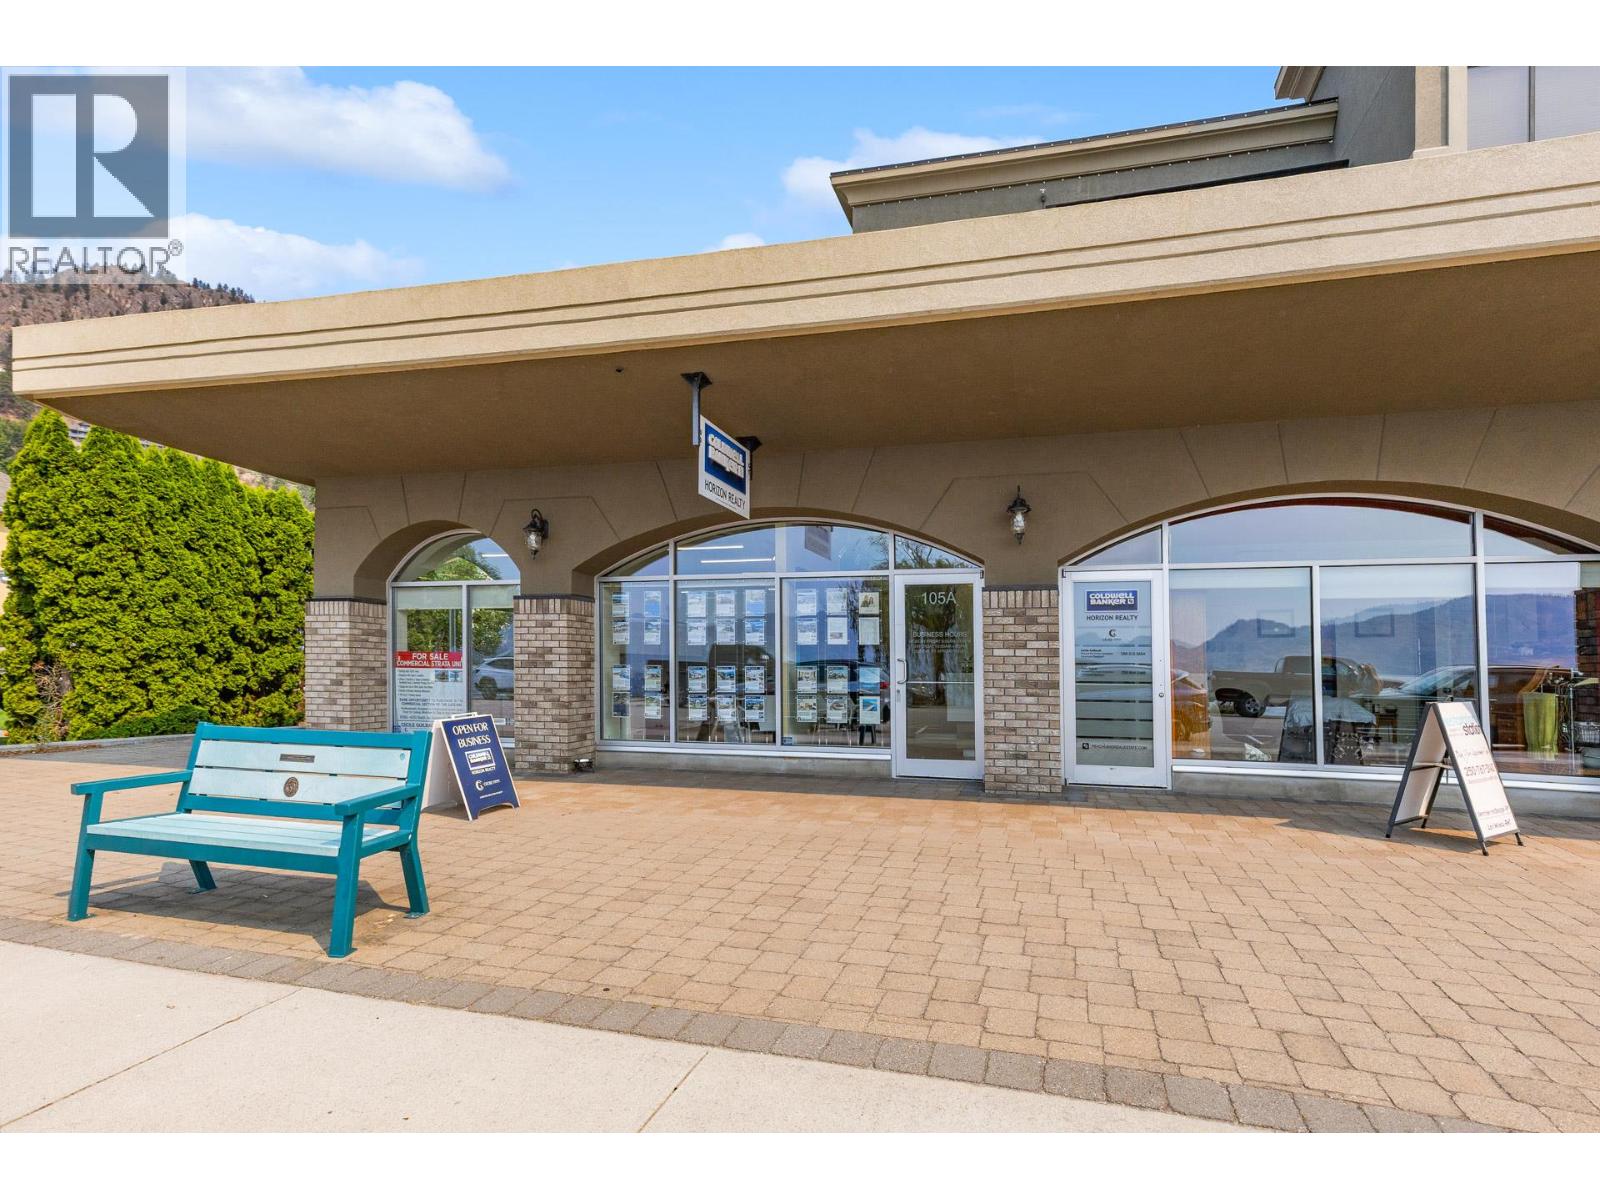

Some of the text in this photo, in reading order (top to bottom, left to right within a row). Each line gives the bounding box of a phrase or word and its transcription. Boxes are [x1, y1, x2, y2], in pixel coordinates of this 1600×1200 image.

[705, 480, 728, 501] HORIZON
[728, 492, 745, 508] REALTY
[922, 592, 956, 605] 105A
[412, 652, 449, 660] FOR SALE
[452, 722, 489, 736] OPEN FOR
[458, 734, 491, 748] BUSINESS
